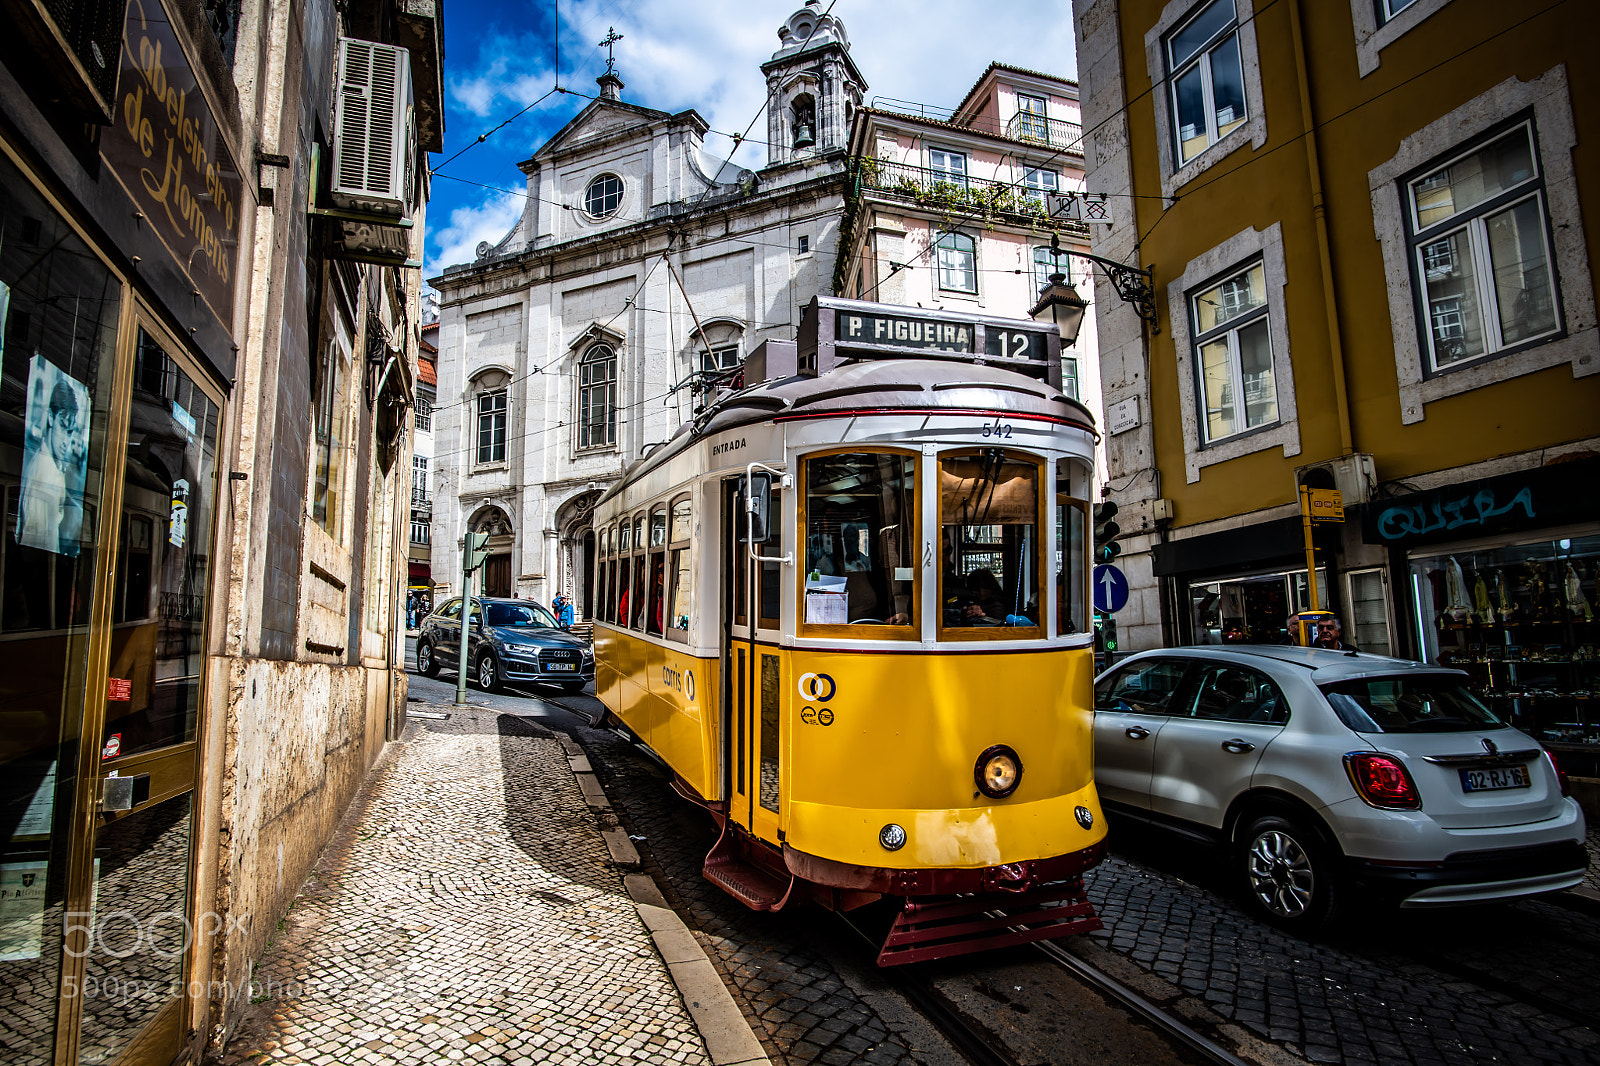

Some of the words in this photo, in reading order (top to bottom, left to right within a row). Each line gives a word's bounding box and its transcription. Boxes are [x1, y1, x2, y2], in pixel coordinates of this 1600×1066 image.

[122, 0, 234, 231] Cabeleireiro
[124, 84, 154, 158] de
[140, 128, 229, 284] Homens
[849, 316, 863, 337] P.
[874, 318, 970, 345] FIGUEIRA
[998, 331, 1030, 361] 12
[982, 422, 1013, 439] 542
[712, 437, 747, 456] ENTRADA
